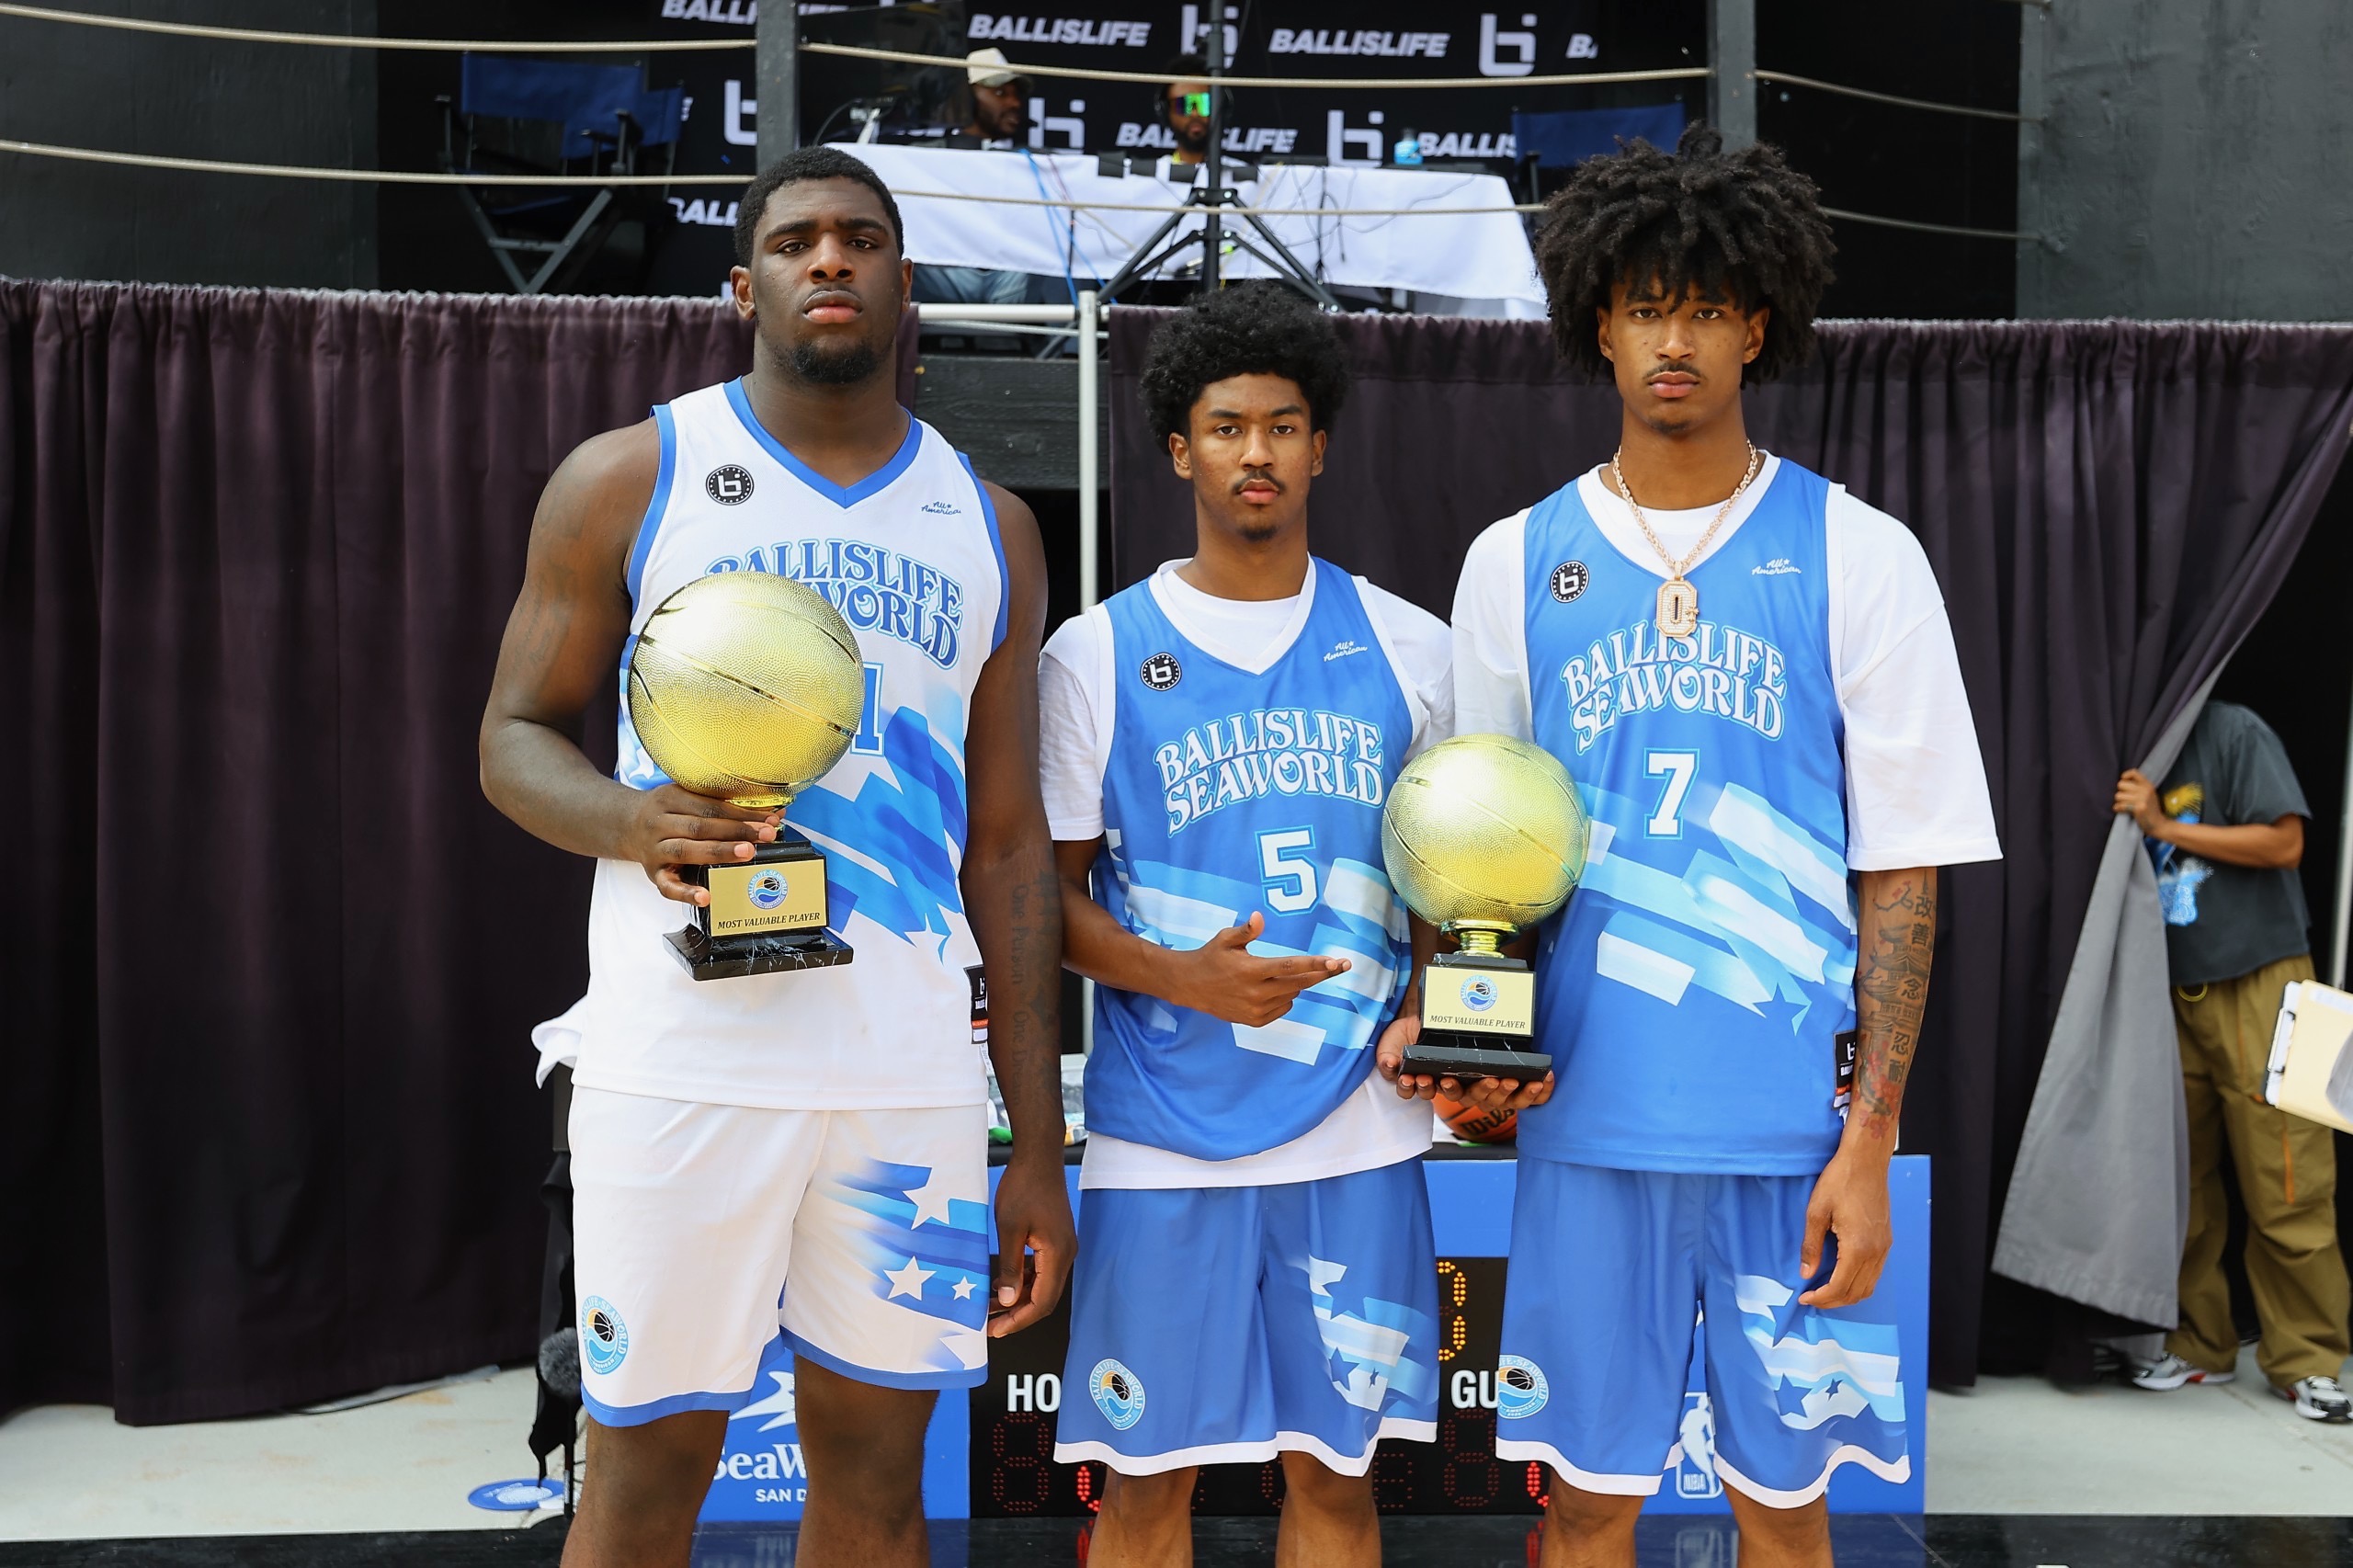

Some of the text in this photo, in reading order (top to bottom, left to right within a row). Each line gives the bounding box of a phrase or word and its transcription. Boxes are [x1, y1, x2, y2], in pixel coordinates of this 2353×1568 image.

[968, 14, 1152, 47] BALLISLIFE
[1268, 28, 1450, 58] BALLISLIFE
[705, 538, 963, 631] LLISLIFE
[1561, 619, 1787, 708] BALLISLIFE
[1153, 708, 1384, 792] BALLISLIFE
[1164, 750, 1384, 838] SEAWORLD
[1643, 748, 1699, 840] 7
[1255, 824, 1321, 917] 5
[717, 913, 821, 930] MOST VALUABLE PLAYER
[1429, 1015, 1527, 1029] MOST VALUABLE PLAYER
[1117, 1364, 1143, 1410] SEAWORLD
[1516, 1358, 1547, 1400] SEAWORLD
[755, 1488, 792, 1503] SAN
